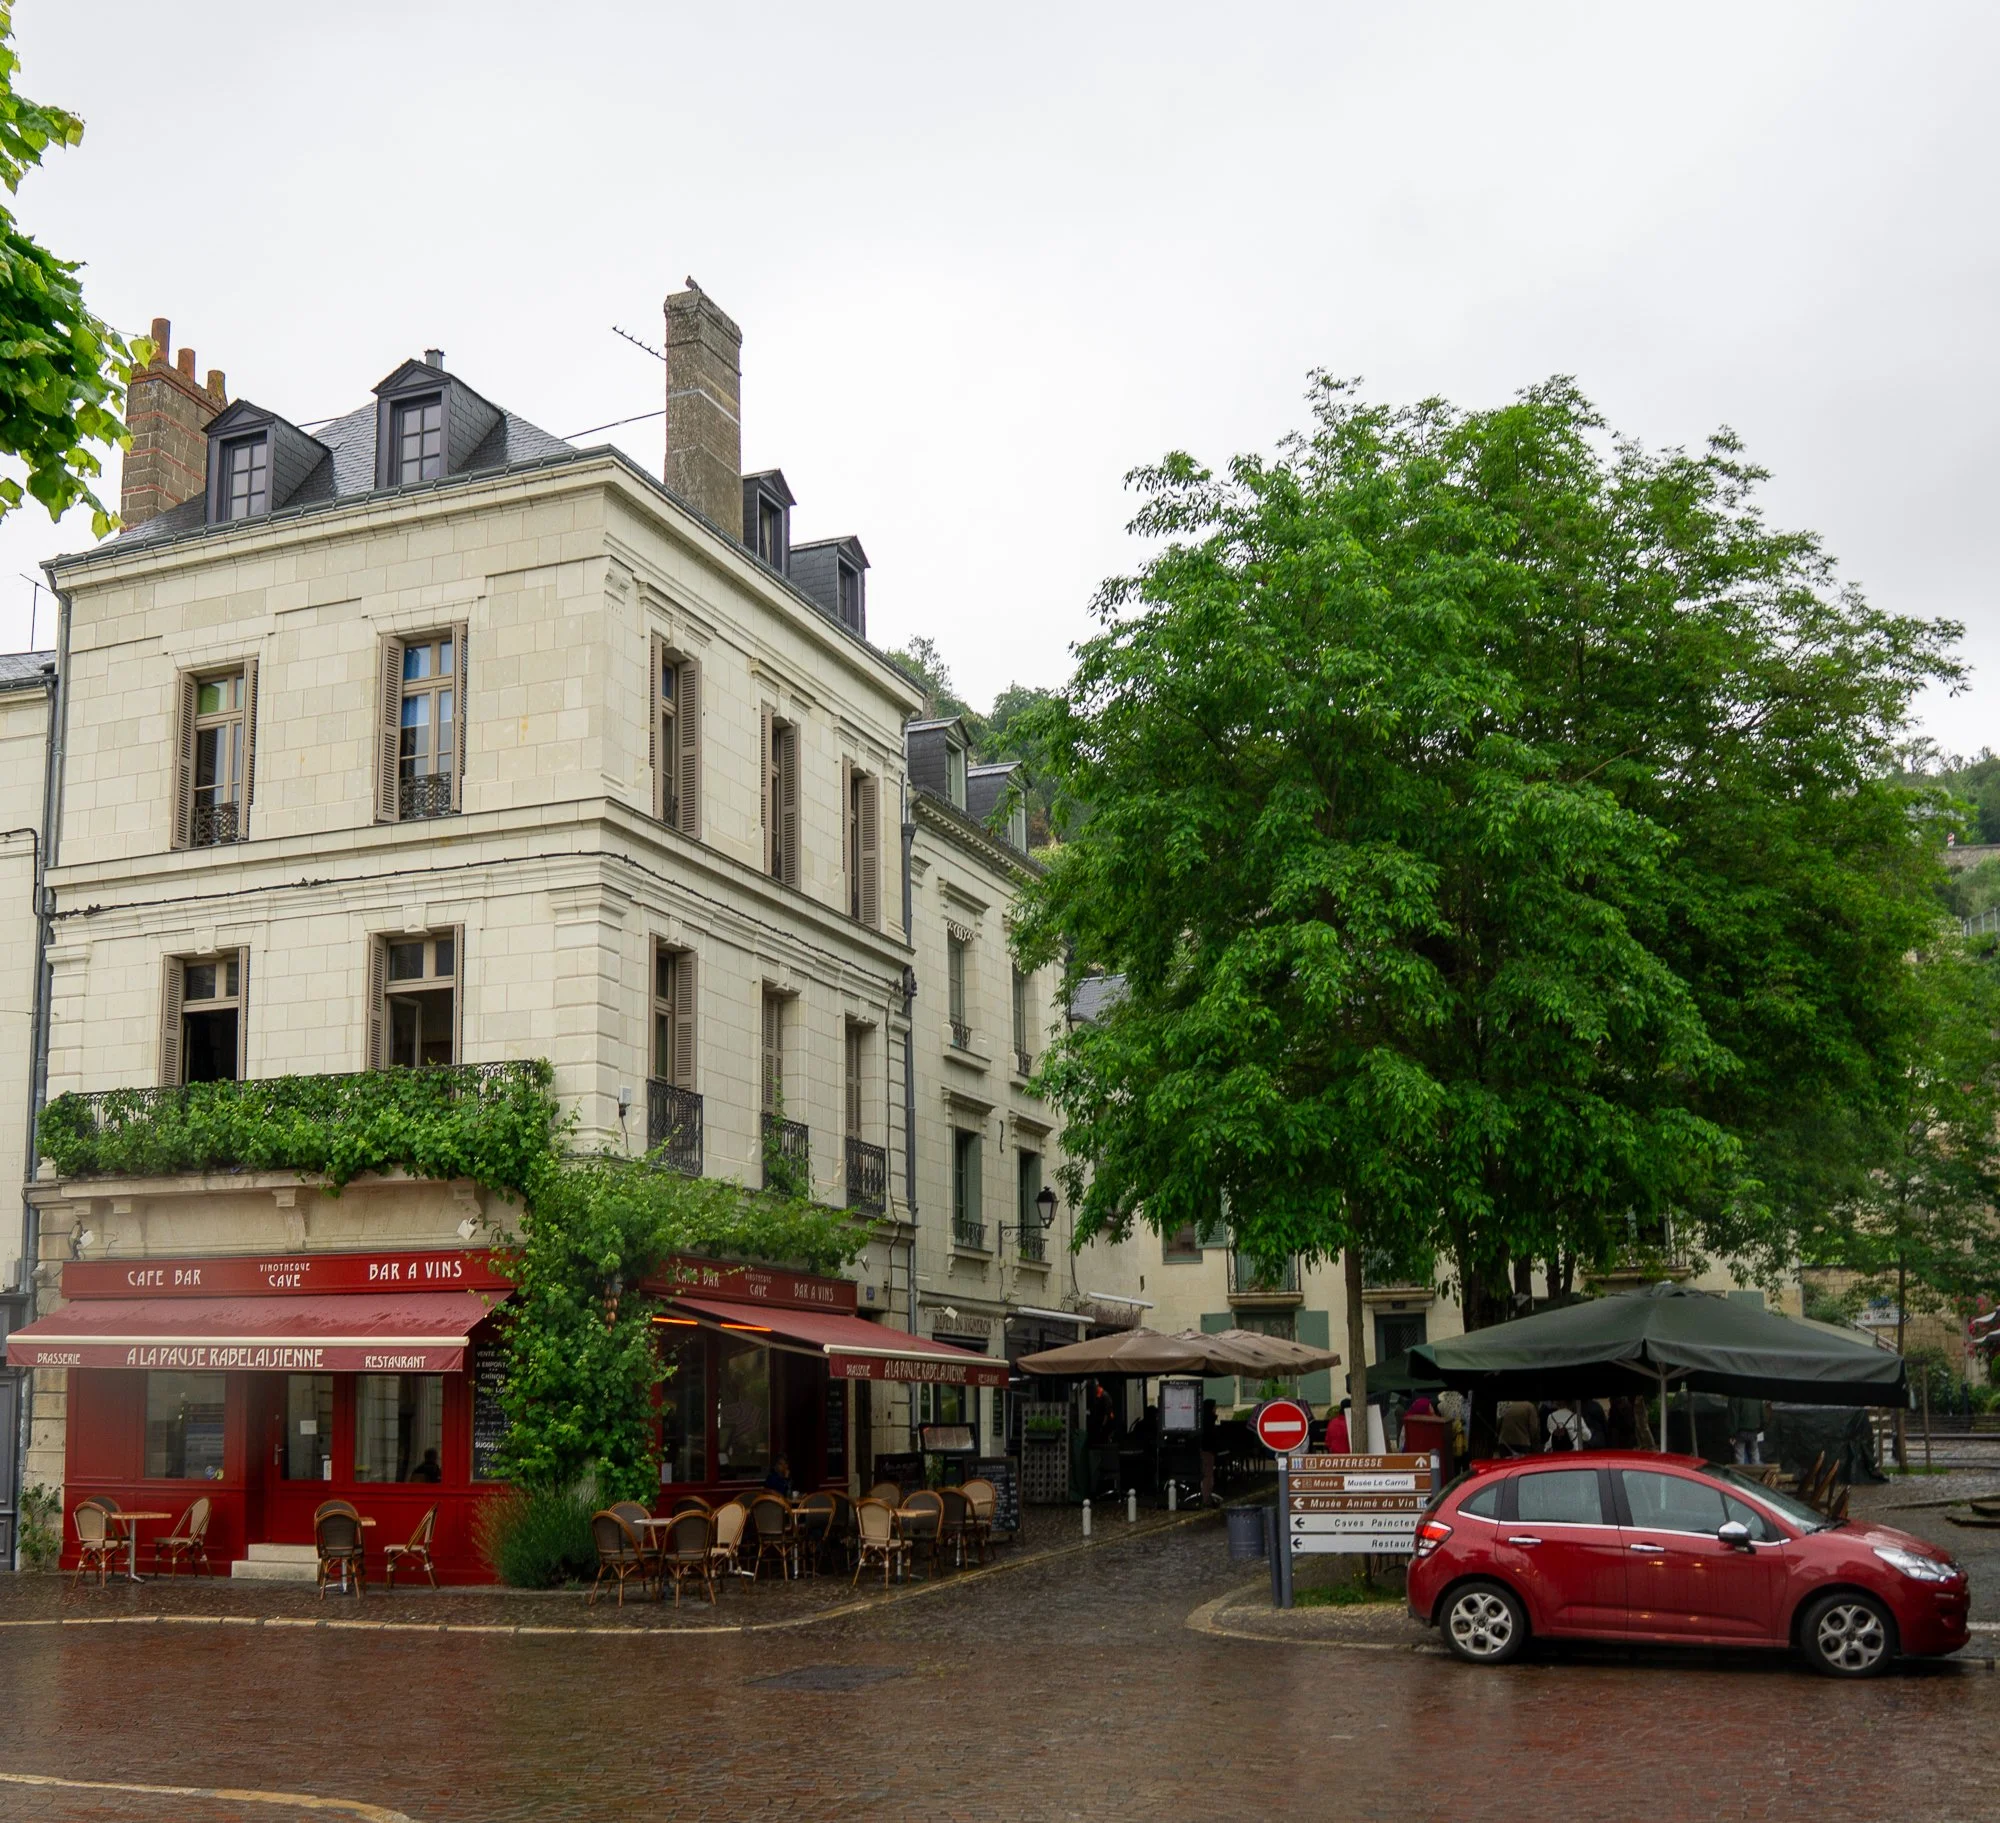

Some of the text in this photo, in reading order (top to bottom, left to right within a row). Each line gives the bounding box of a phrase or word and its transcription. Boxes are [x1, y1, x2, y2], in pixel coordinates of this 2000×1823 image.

[259, 1262, 311, 1272] VINOTHEQUE
[369, 1260, 463, 1280] BAR A VINS
[127, 1269, 201, 1286] CAFE BAR
[268, 1274, 301, 1287] CAVE
[749, 1284, 767, 1297] CAVE
[794, 1282, 809, 1298] BAR
[817, 1286, 834, 1302] VINS
[37, 1352, 81, 1364] BRASSERIE
[126, 1347, 323, 1368] A LA PAUSE RABELAISIENNE
[365, 1355, 426, 1369] RESTAURANT
[1319, 1458, 1383, 1468] FORTERESSE
[1347, 1478, 1372, 1487] Musée
[1310, 1498, 1414, 1508] Musée Animé du Vin
[1334, 1518, 1416, 1528] Caves Painctes
[1371, 1539, 1414, 1548] Restaur
